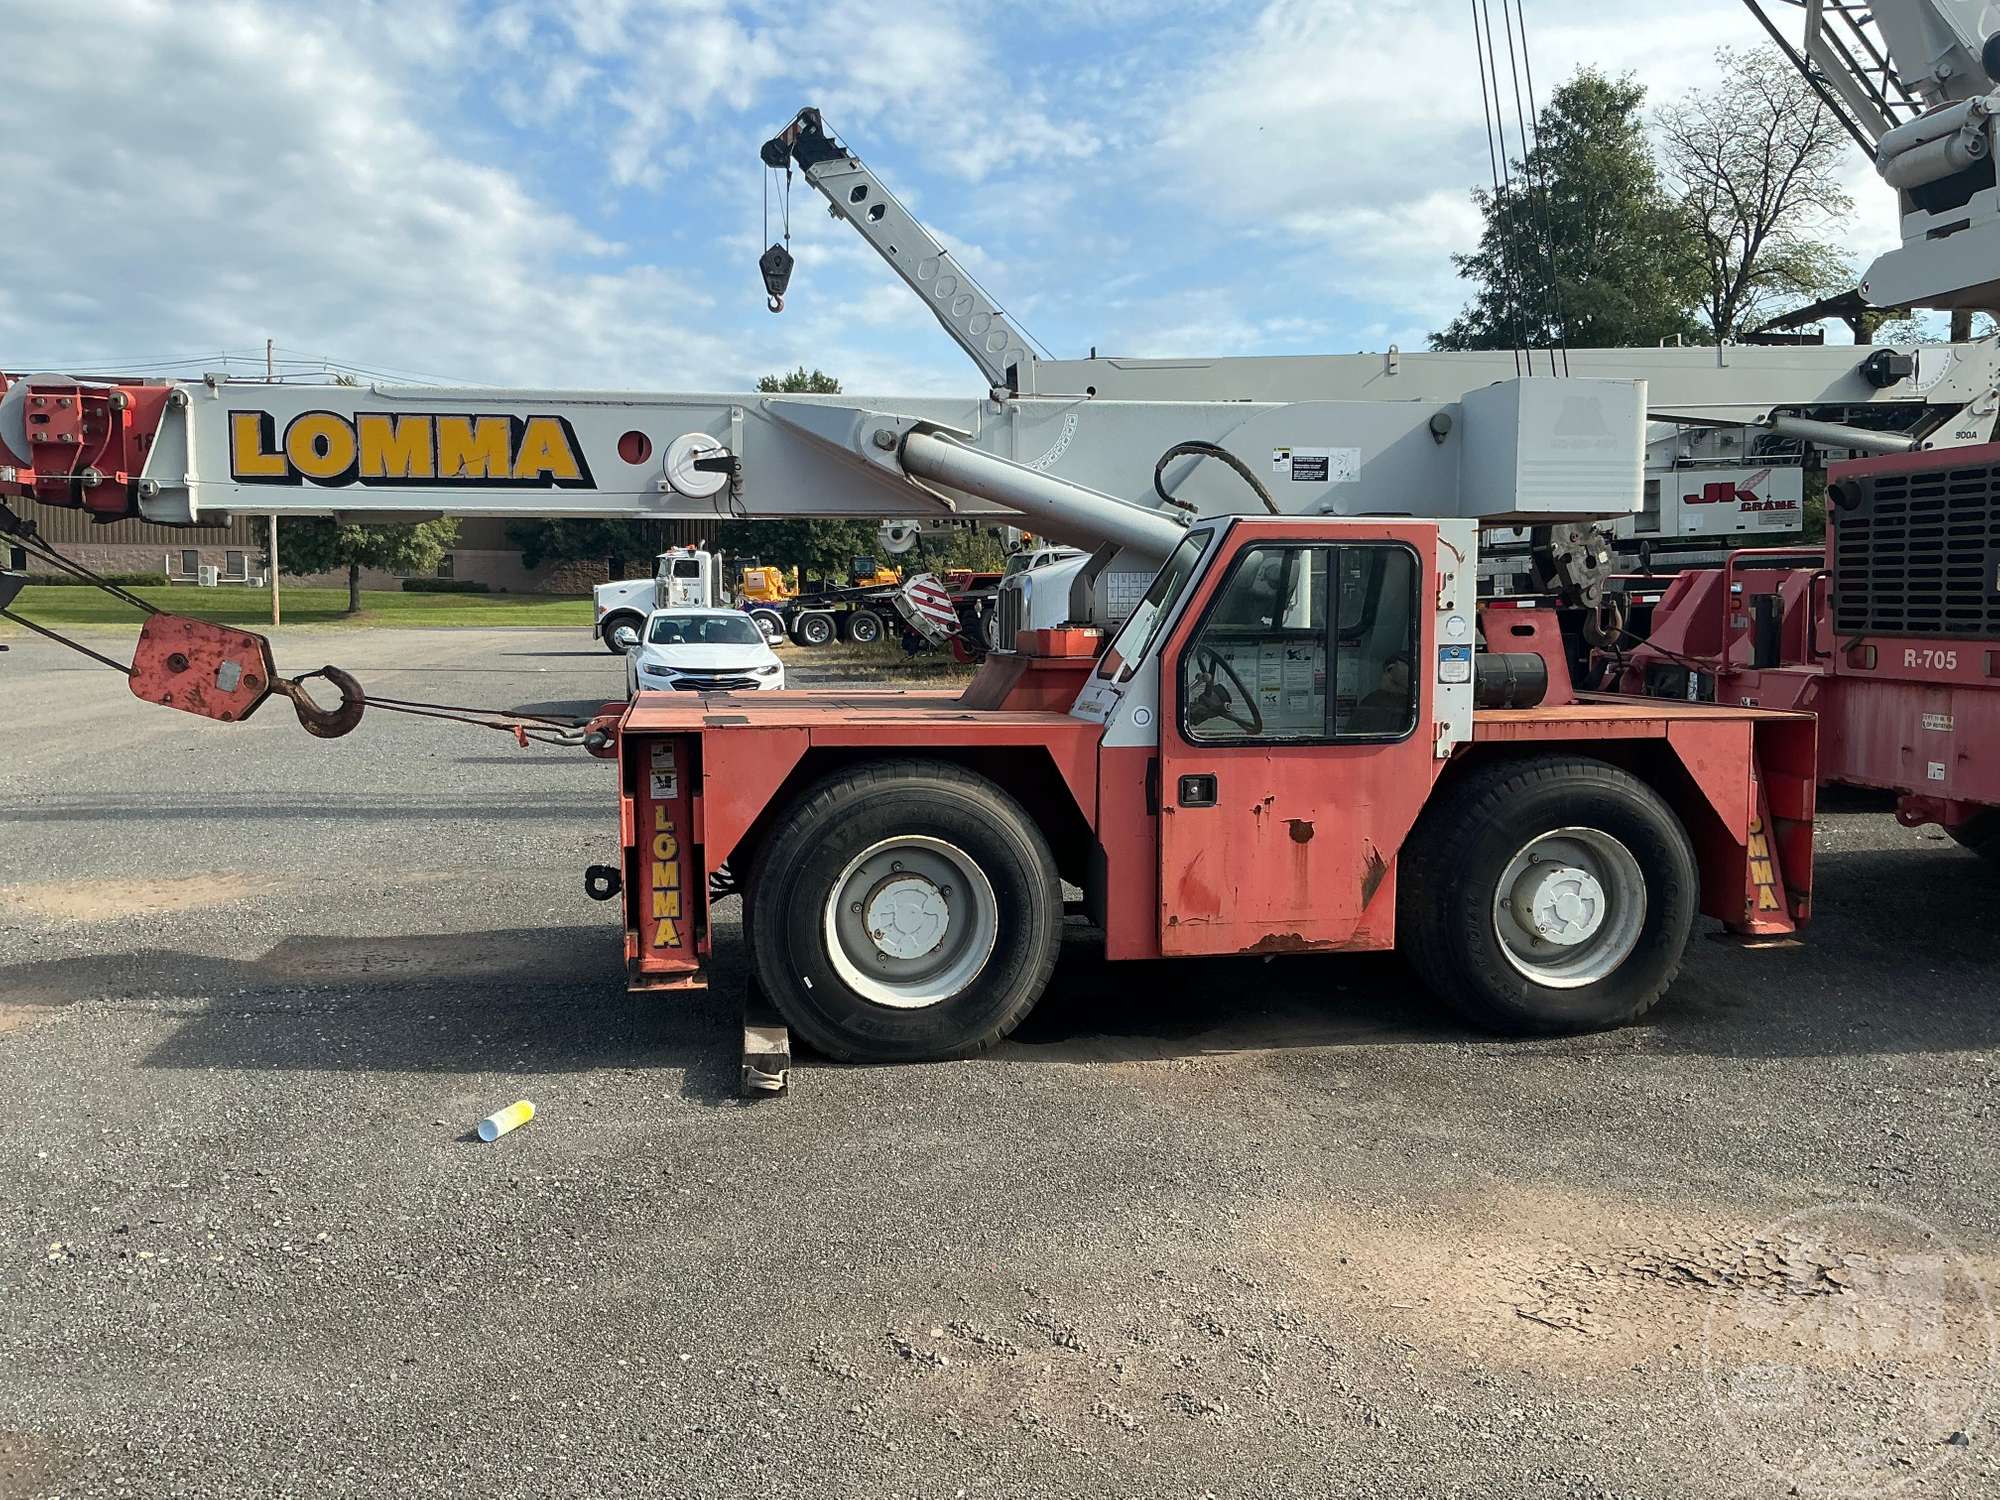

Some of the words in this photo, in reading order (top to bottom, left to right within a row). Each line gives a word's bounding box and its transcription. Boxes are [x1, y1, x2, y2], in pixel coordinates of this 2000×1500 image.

[228, 409, 597, 489] LOMMA
[1683, 476, 1762, 505] JK
[1740, 500, 1797, 512] CRANE
[1904, 648, 1957, 670] R-705
[652, 805, 682, 949] LOMMA
